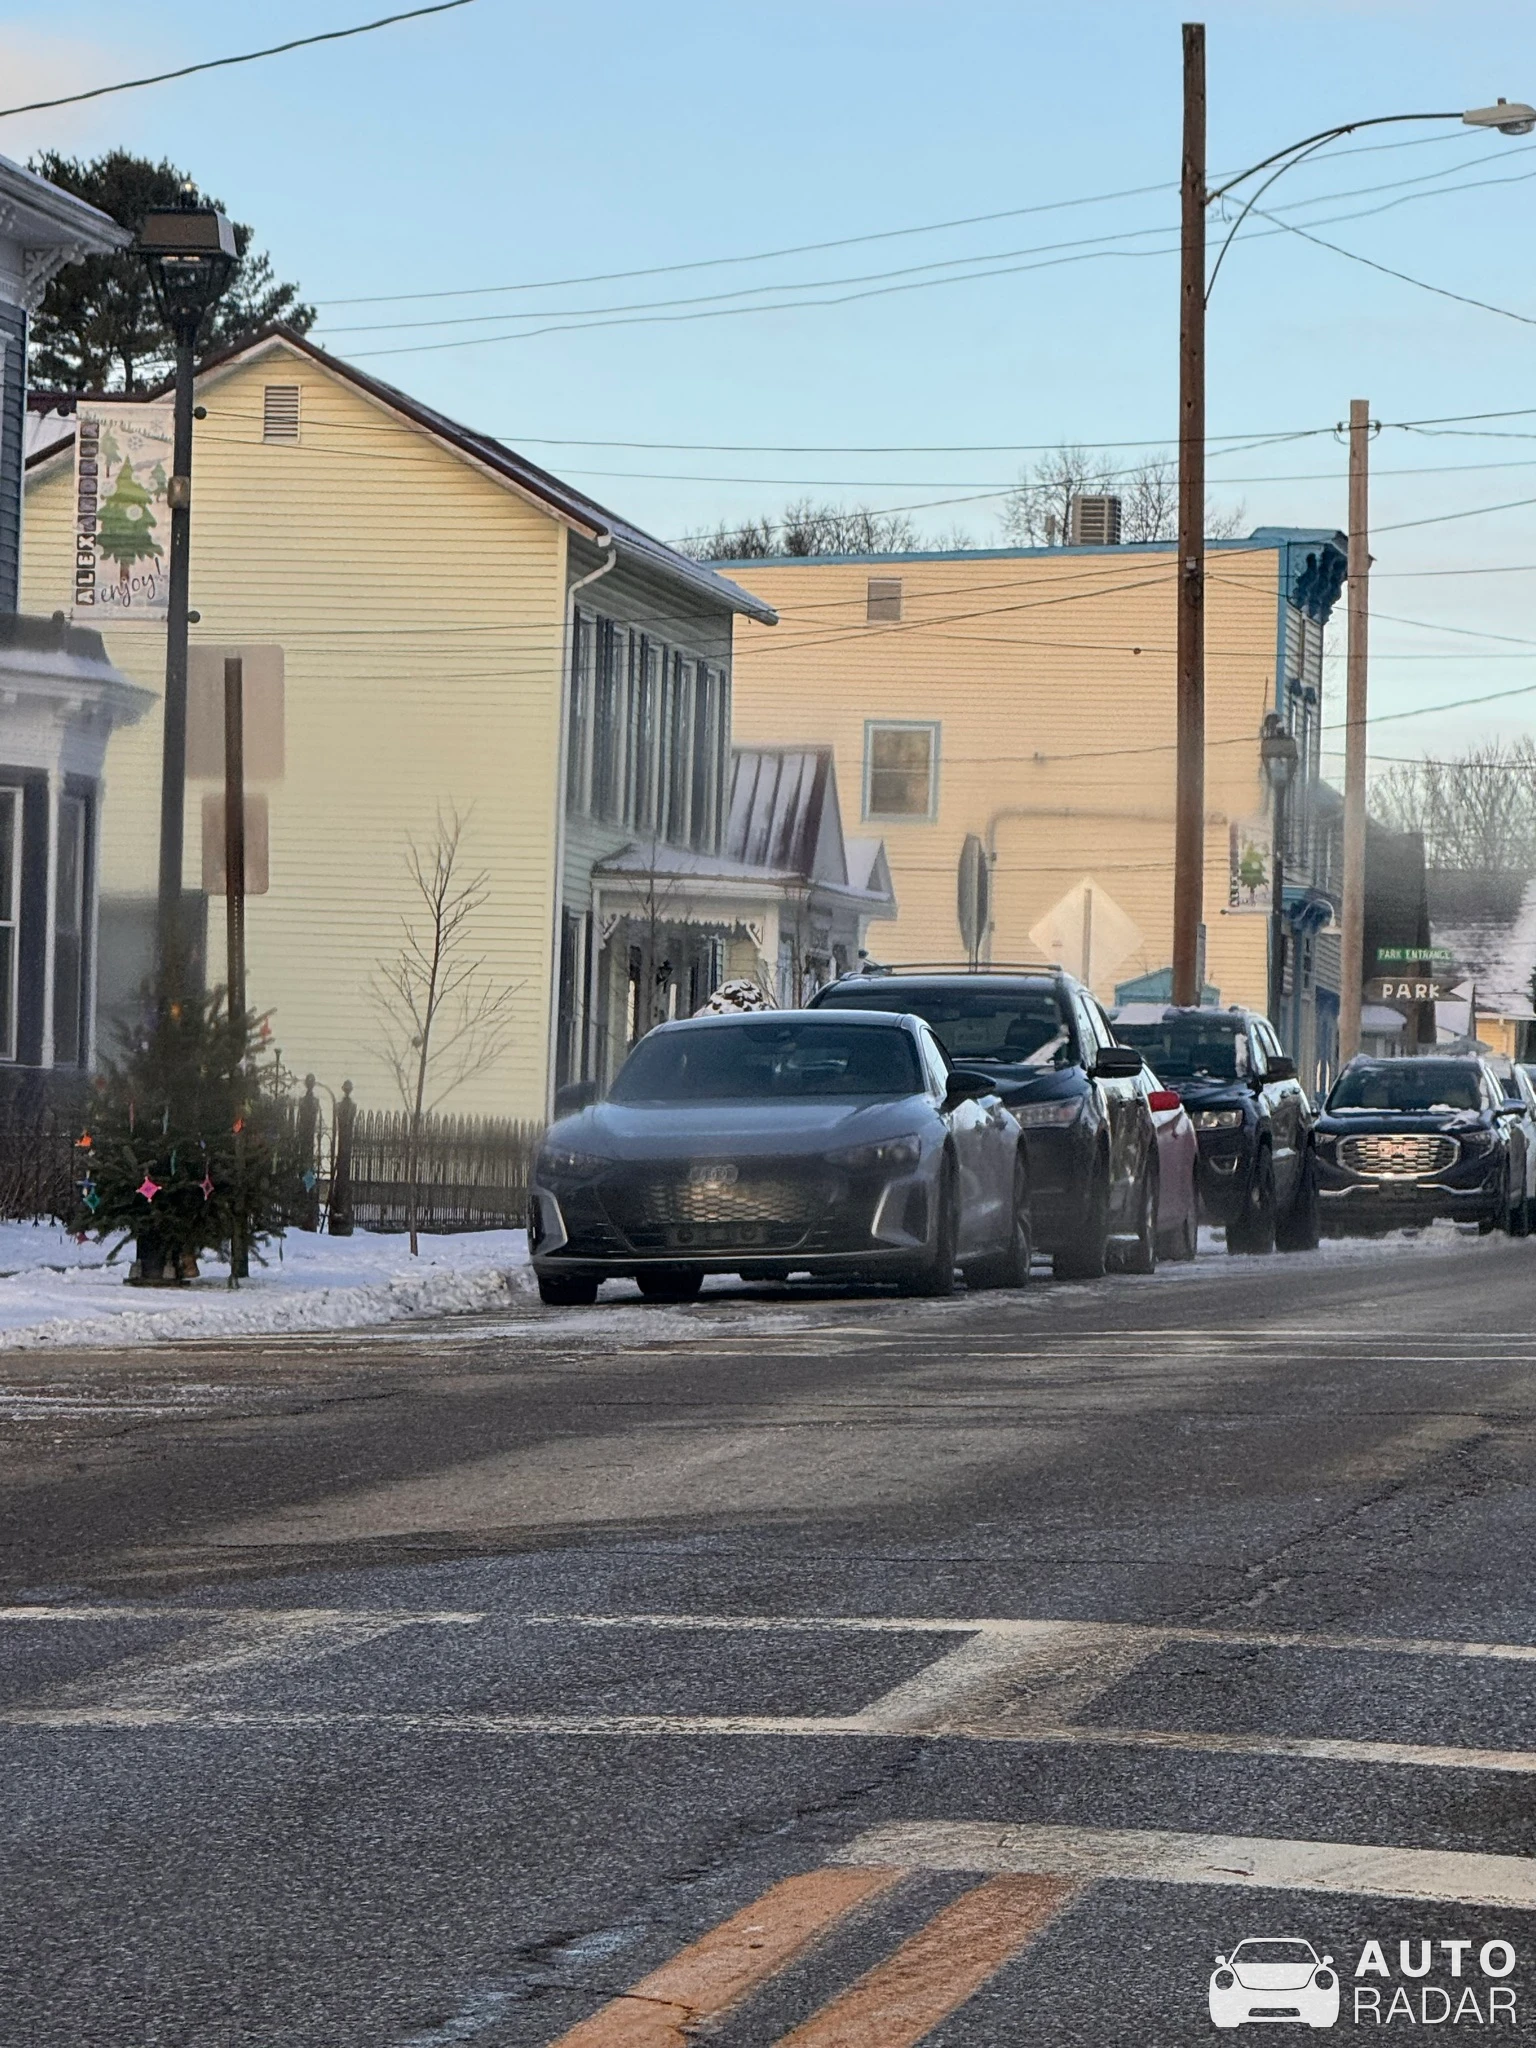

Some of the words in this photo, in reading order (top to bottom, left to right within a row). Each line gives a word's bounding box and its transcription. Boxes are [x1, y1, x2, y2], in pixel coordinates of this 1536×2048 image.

[101, 557, 162, 607] enjoy!
[1379, 949, 1402, 959] PARK
[1406, 949, 1450, 960] ENTRANCE
[1382, 983, 1440, 999] PARK
